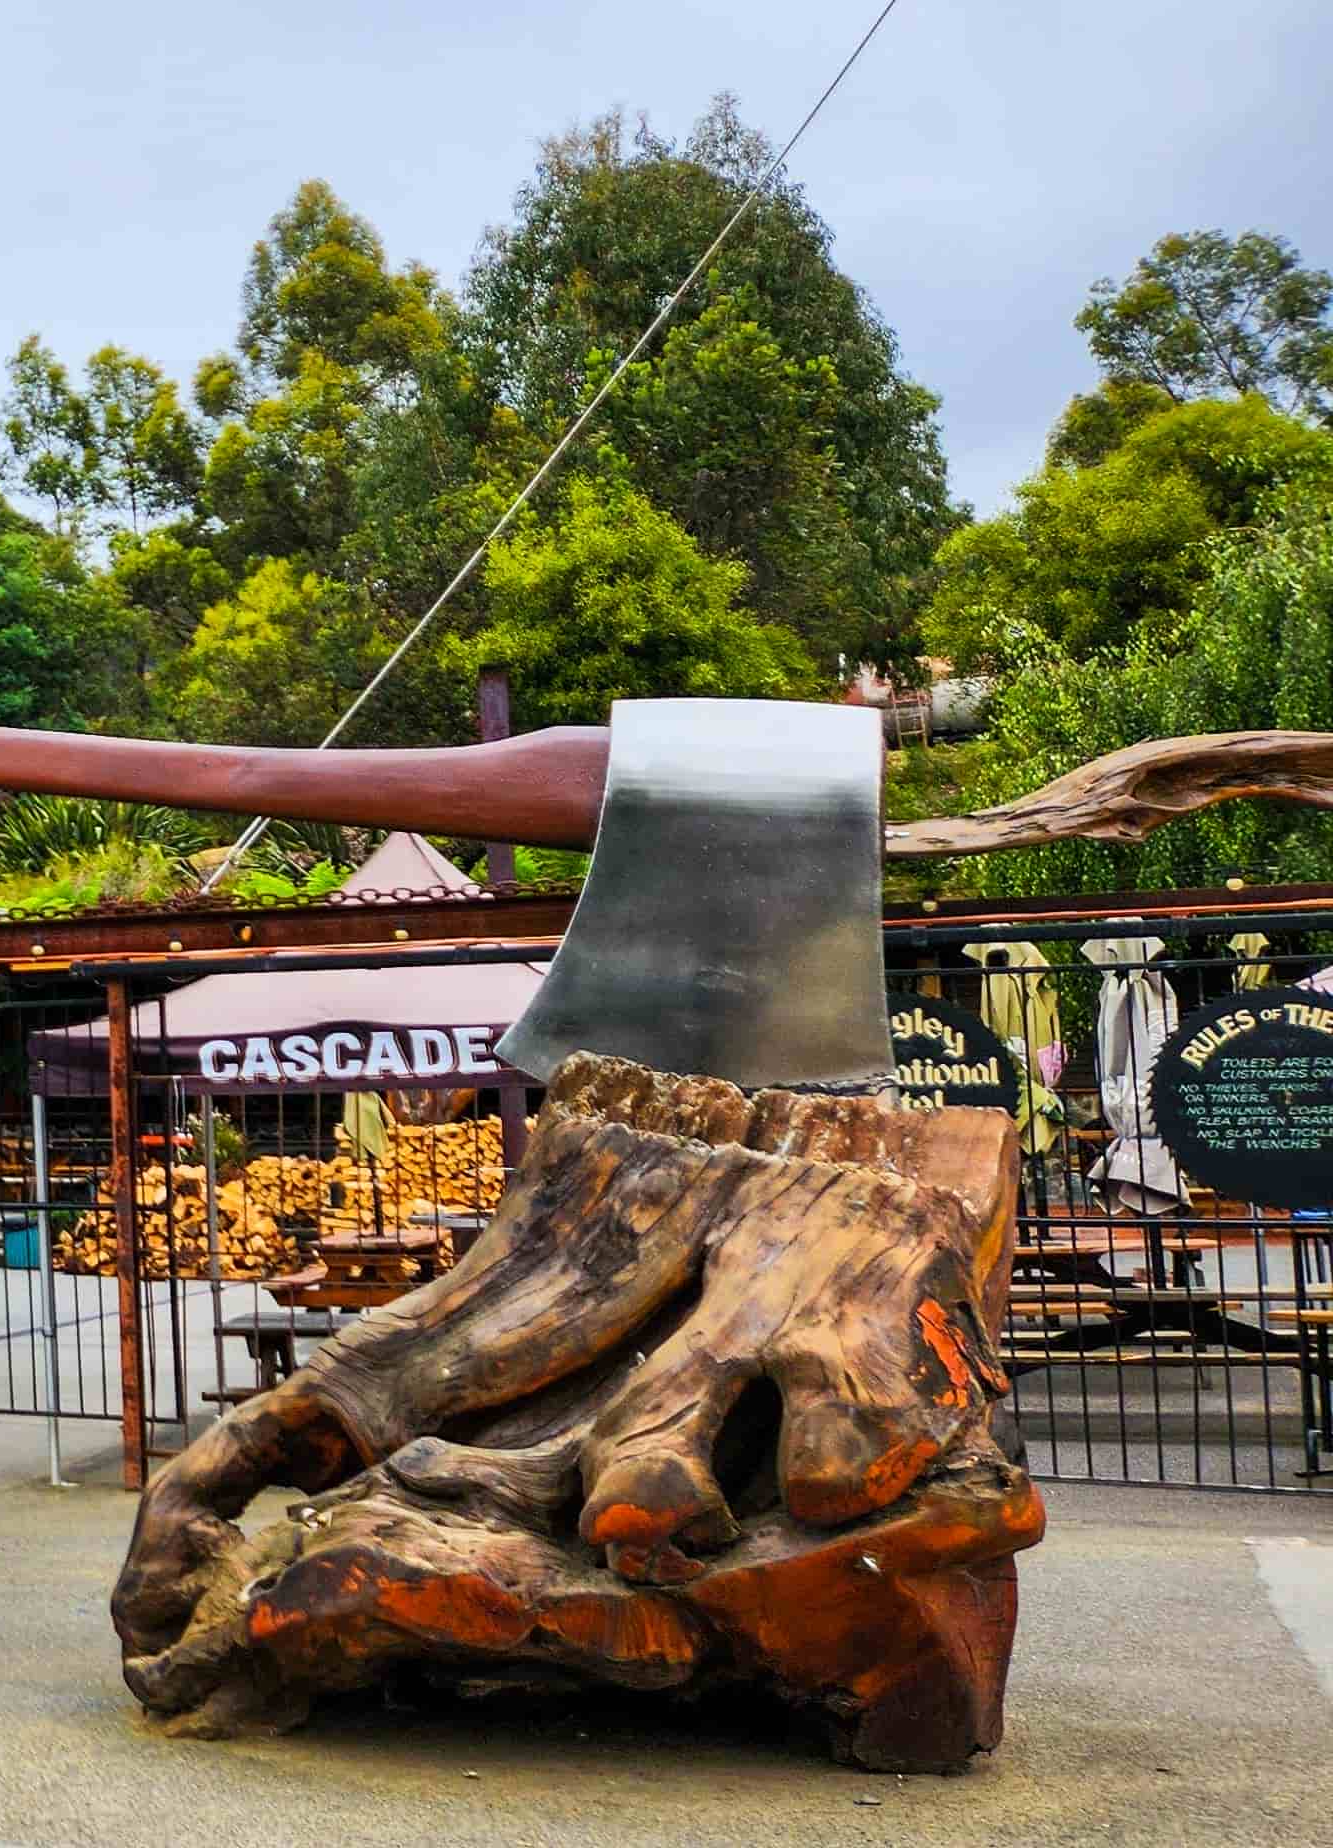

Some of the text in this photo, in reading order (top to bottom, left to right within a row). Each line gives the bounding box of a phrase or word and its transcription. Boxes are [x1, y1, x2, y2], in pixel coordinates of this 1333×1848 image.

[890, 1007, 965, 1058] gley
[1180, 1003, 1333, 1072] RULES OF THE
[198, 1026, 501, 1083] CASCADE
[1221, 1057, 1333, 1068] TOILETS ARE FO
[894, 1056, 1000, 1086] ational
[1221, 1069, 1333, 1079] CUSTOMERS ON
[1179, 1083, 1200, 1093] NO
[900, 1089, 944, 1112] tel
[1185, 1093, 1269, 1103] OR TINKERS
[1187, 1106, 1206, 1115] NO
[1212, 1106, 1277, 1116] SKULKING
[1197, 1116, 1333, 1126] FLEA BITTEN TRAM
[1197, 1129, 1219, 1139] NO
[1225, 1128, 1262, 1139] SLAP
[1208, 1139, 1321, 1149] THE WENCHES
